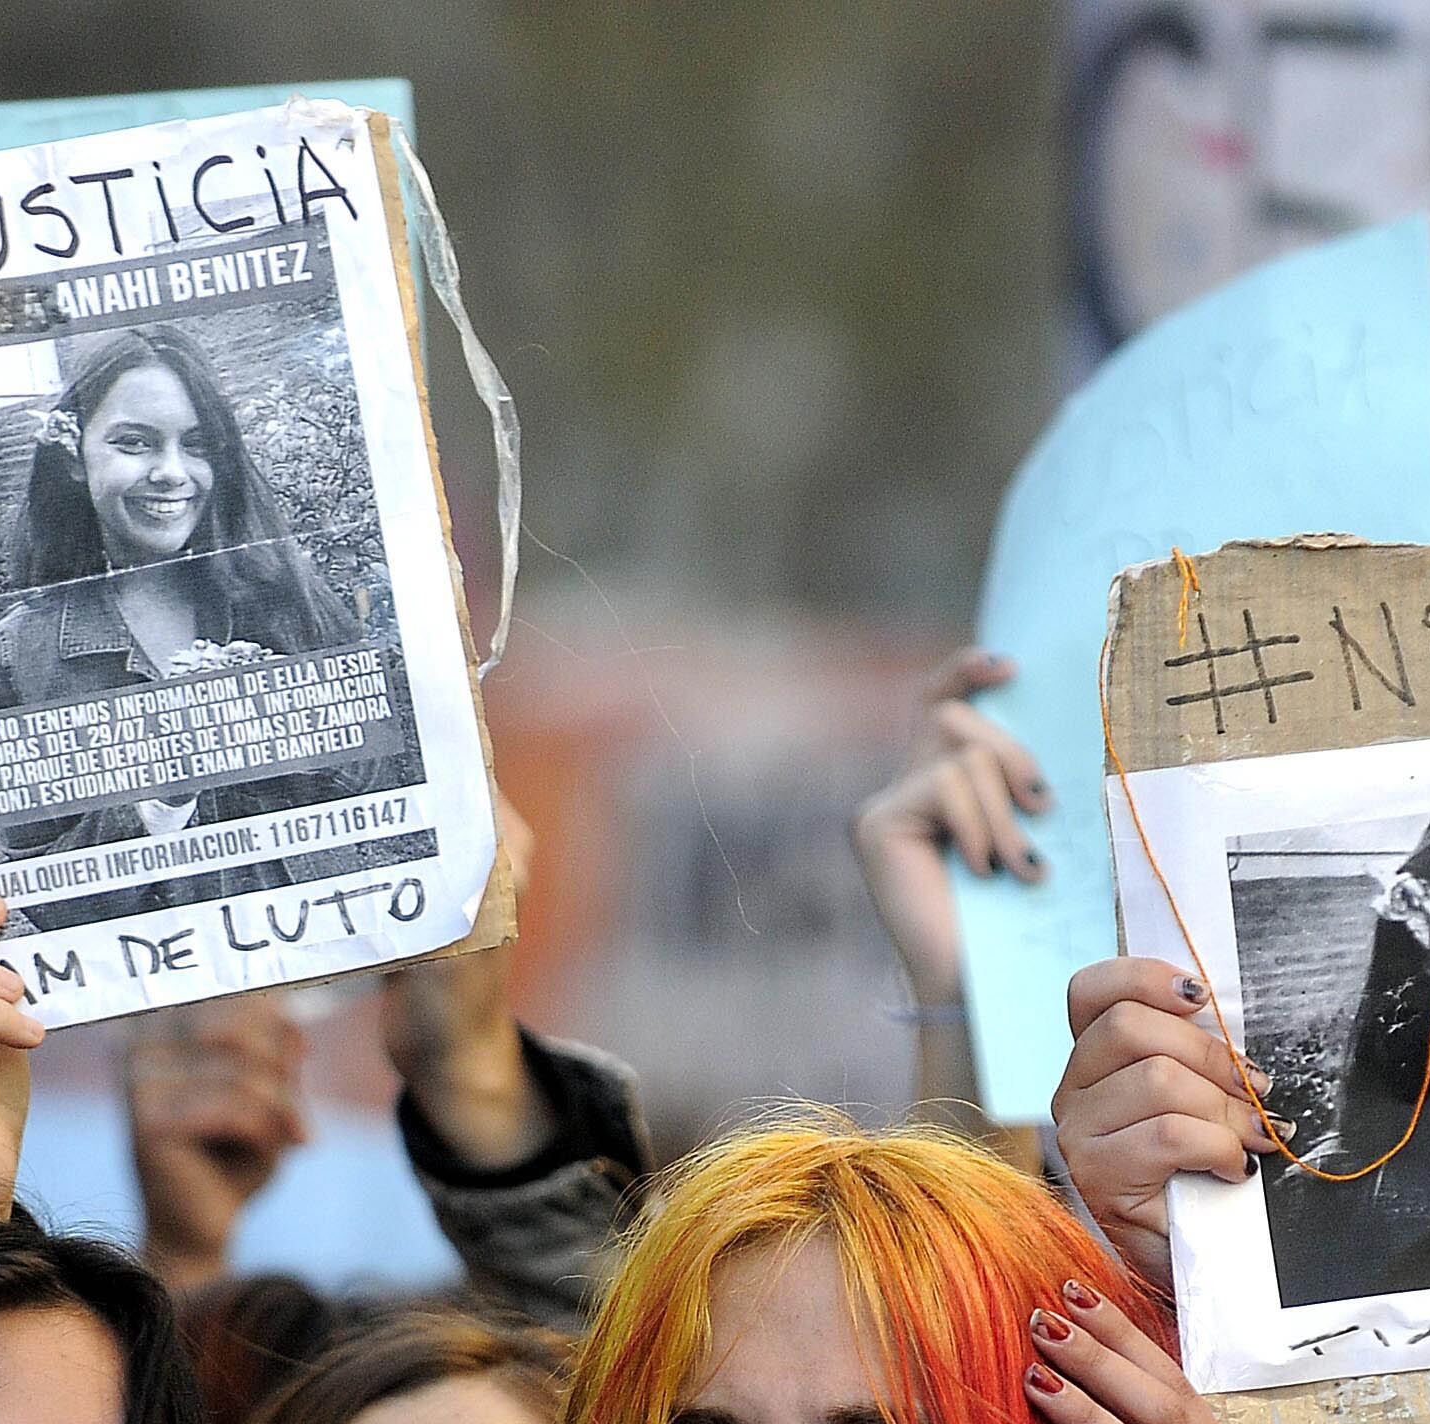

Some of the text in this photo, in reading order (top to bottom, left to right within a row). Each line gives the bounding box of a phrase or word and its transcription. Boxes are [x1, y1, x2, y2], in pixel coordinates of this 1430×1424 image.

[57, 267, 161, 320] ANAHI
[169, 242, 313, 302] BENITEZ
[23, 701, 111, 735] TENEMOS
[115, 676, 239, 720] INFORMACION
[244, 670, 270, 696] DE
[273, 662, 319, 689] ELLA
[324, 649, 383, 679] DESDE
[46, 731, 82, 754] DEL
[160, 713, 183, 735] SU
[190, 697, 259, 728] ULTIMA
[264, 672, 388, 715] INFORMACION
[0, 755, 73, 785] PARQUE
[75, 750, 101, 772] DE
[102, 731, 194, 768] DEPORTES
[197, 727, 221, 751] DE
[223, 715, 286, 745] LOMAS
[287, 710, 313, 736] DE
[314, 695, 392, 731] ZAMORA
[40, 762, 151, 807] ESTUDIANTE
[154, 759, 189, 784] DEL
[191, 744, 245, 777] ENAM
[247, 740, 274, 767] DE
[274, 723, 364, 762] BANFIELD
[105, 826, 261, 877] INFORMACION:
[269, 797, 408, 848] 1167116147
[118, 877, 426, 979] DE LUTO
